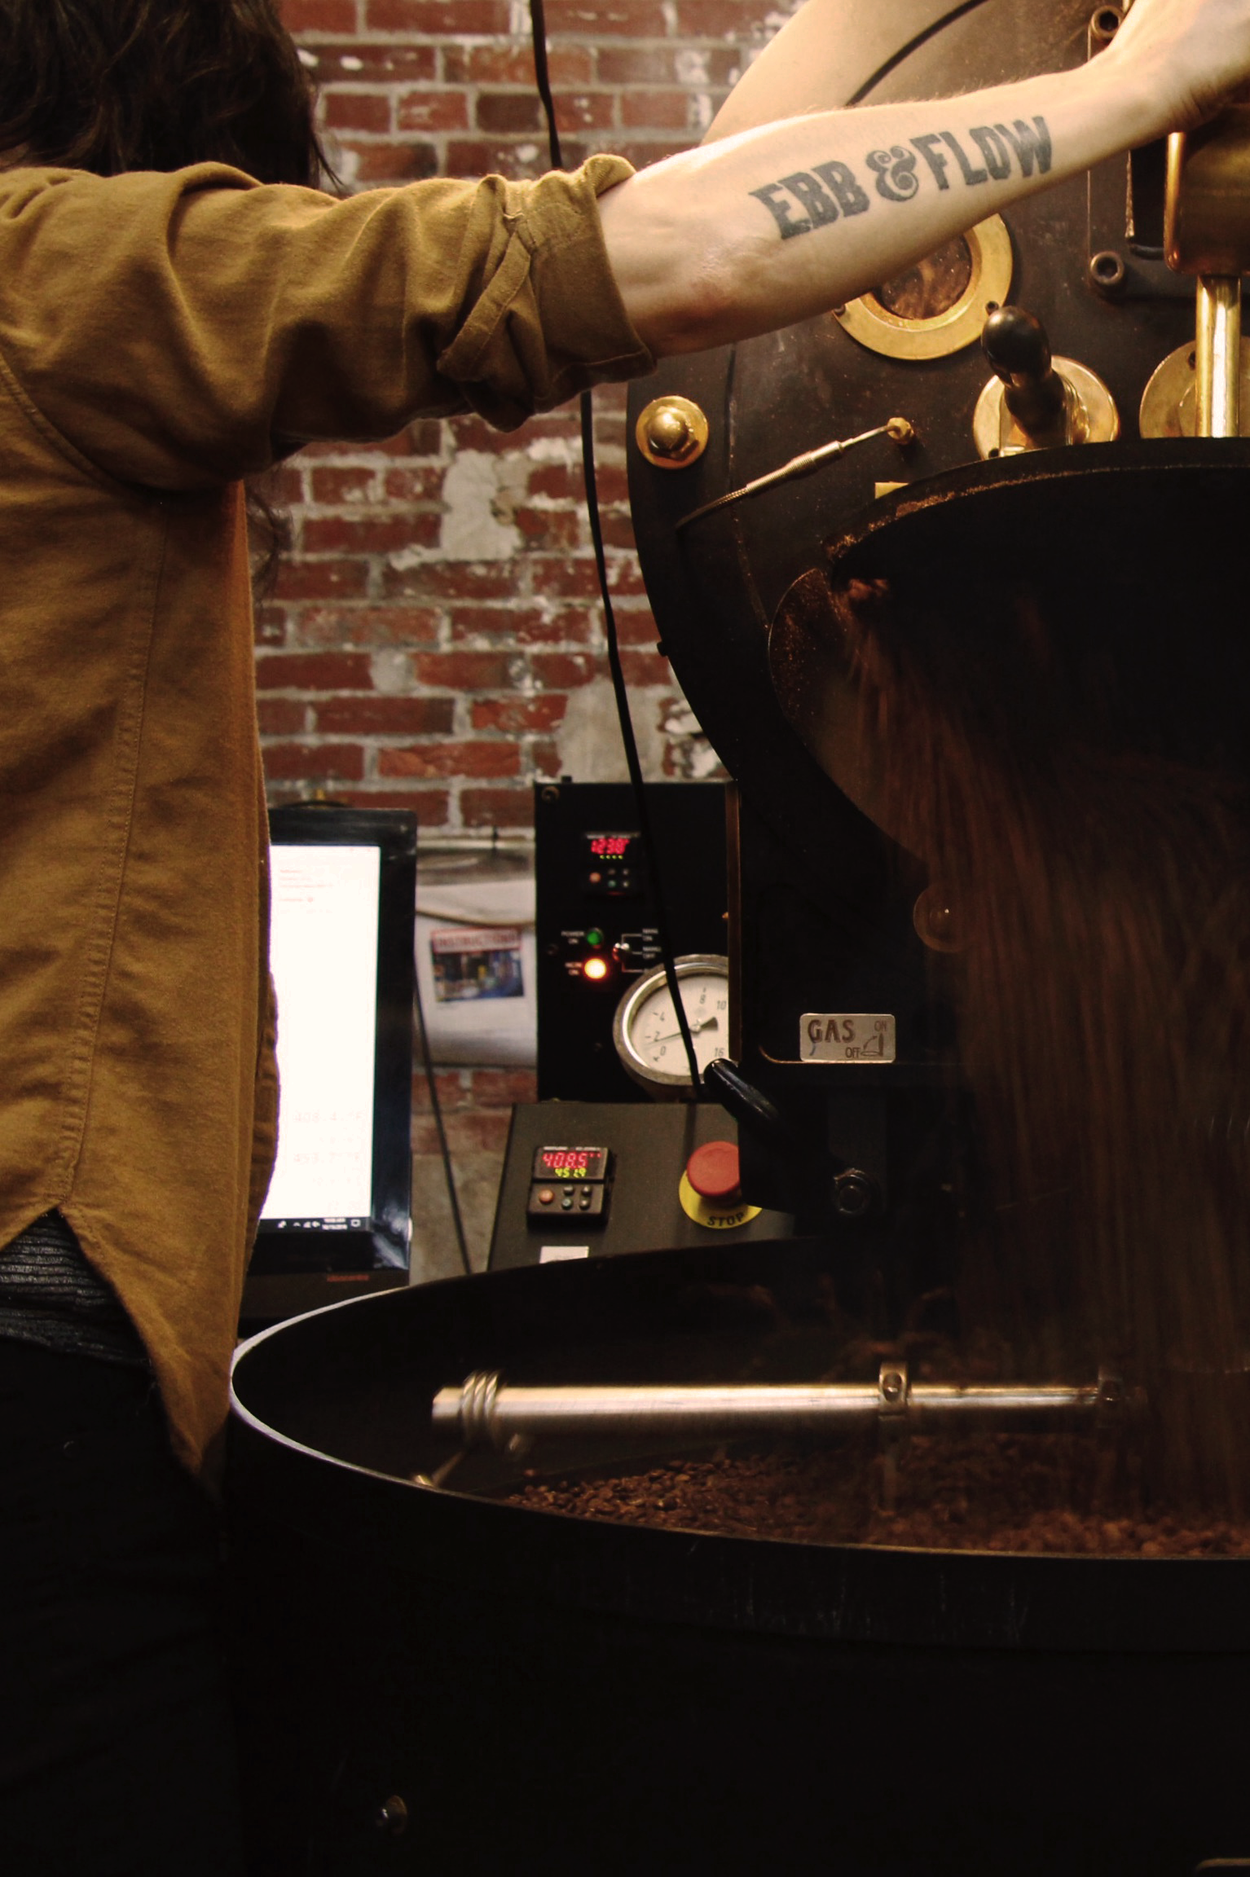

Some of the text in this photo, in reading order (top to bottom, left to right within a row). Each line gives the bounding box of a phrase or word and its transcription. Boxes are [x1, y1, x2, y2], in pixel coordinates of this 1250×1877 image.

[748, 116, 1052, 240] EBB & FLOW
[807, 1019, 888, 1043] GAS ON
[845, 1046, 861, 1059] OFF
[707, 1212, 745, 1227] STOP
